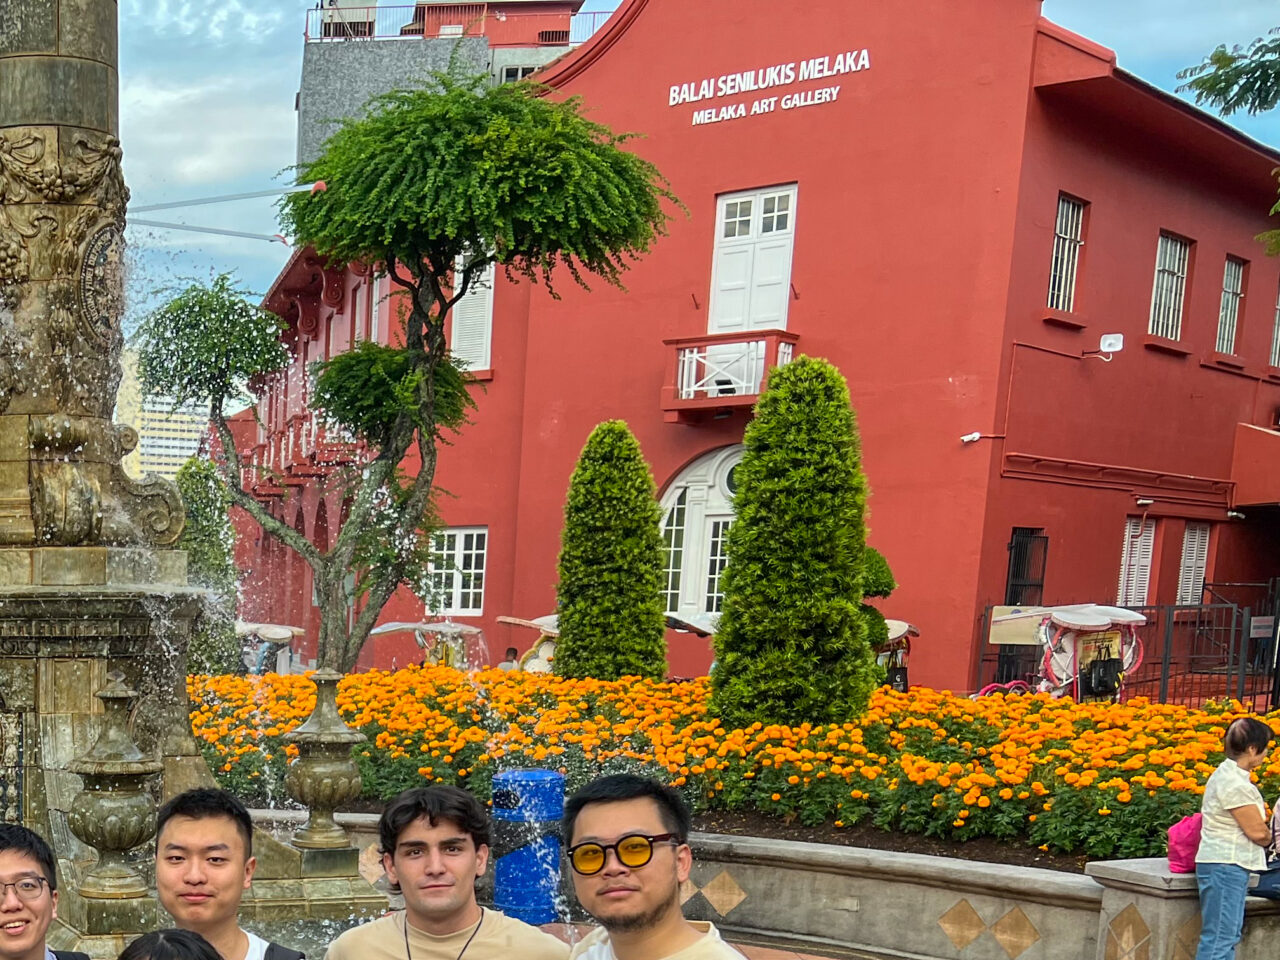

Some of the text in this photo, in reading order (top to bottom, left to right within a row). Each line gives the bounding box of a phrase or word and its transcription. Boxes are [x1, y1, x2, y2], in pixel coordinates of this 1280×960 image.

[669, 49, 870, 105] BALAI SENILUKIS MELAKA
[692, 86, 840, 126] MELAKA ART GALLERY
